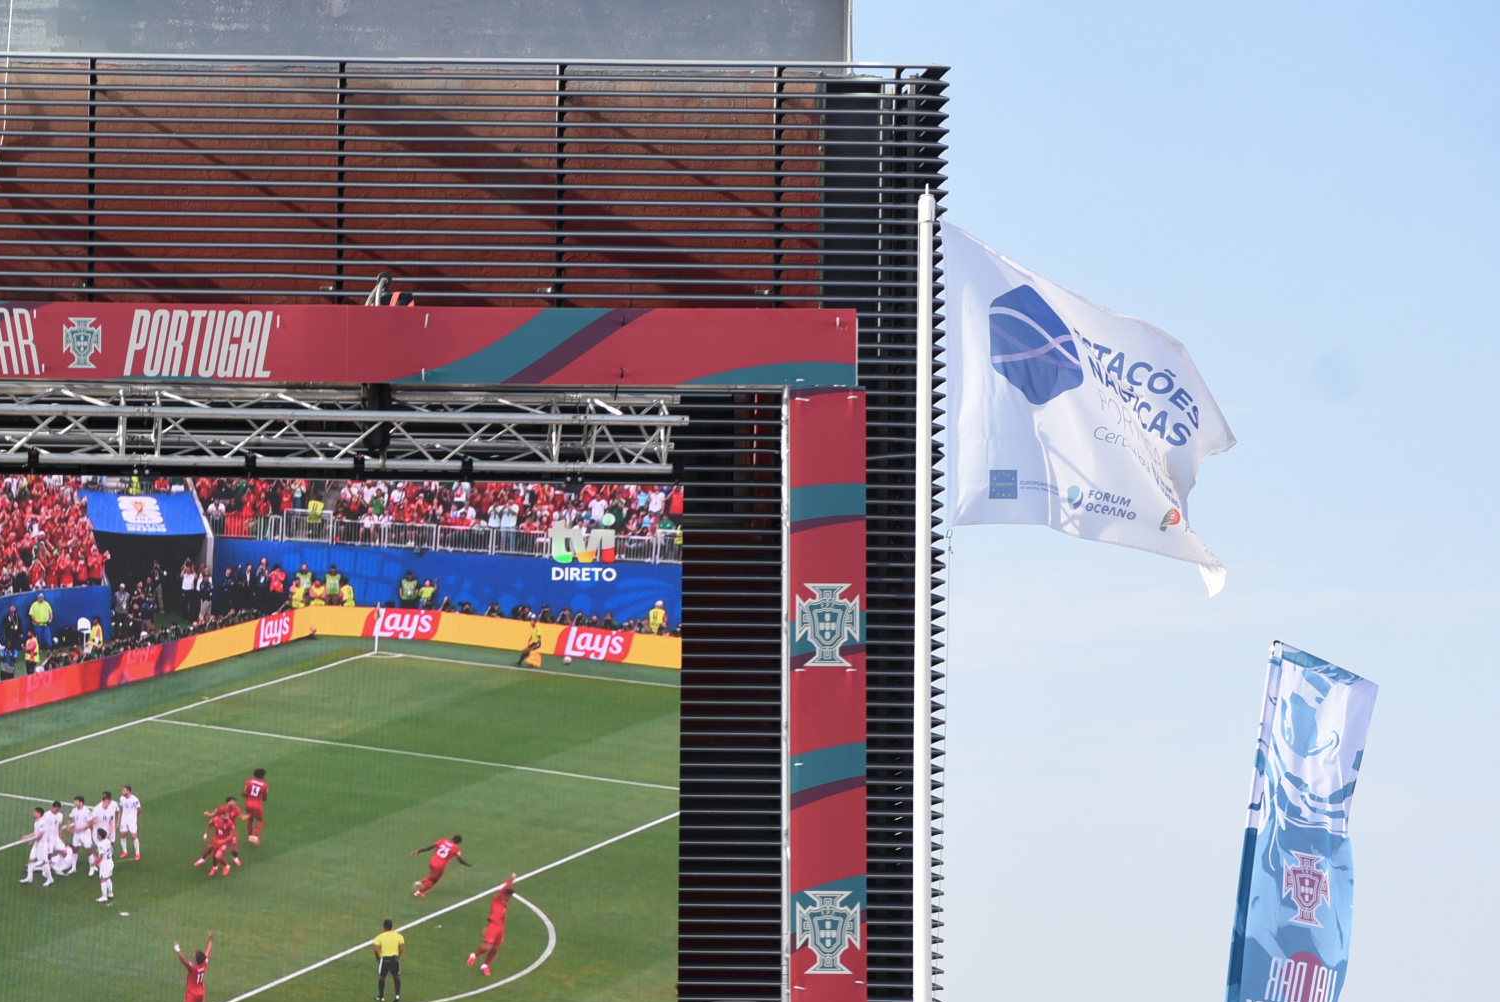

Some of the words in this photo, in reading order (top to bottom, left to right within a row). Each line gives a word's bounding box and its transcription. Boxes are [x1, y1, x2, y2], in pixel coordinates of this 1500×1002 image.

[123, 309, 274, 378] PORTUGAL
[1088, 489, 1132, 507] FORUM
[548, 512, 616, 564] tvi
[551, 566, 617, 582] DIRETO
[258, 613, 290, 648] Lay's
[373, 607, 432, 640] Lay's
[564, 625, 624, 661] Lay's
